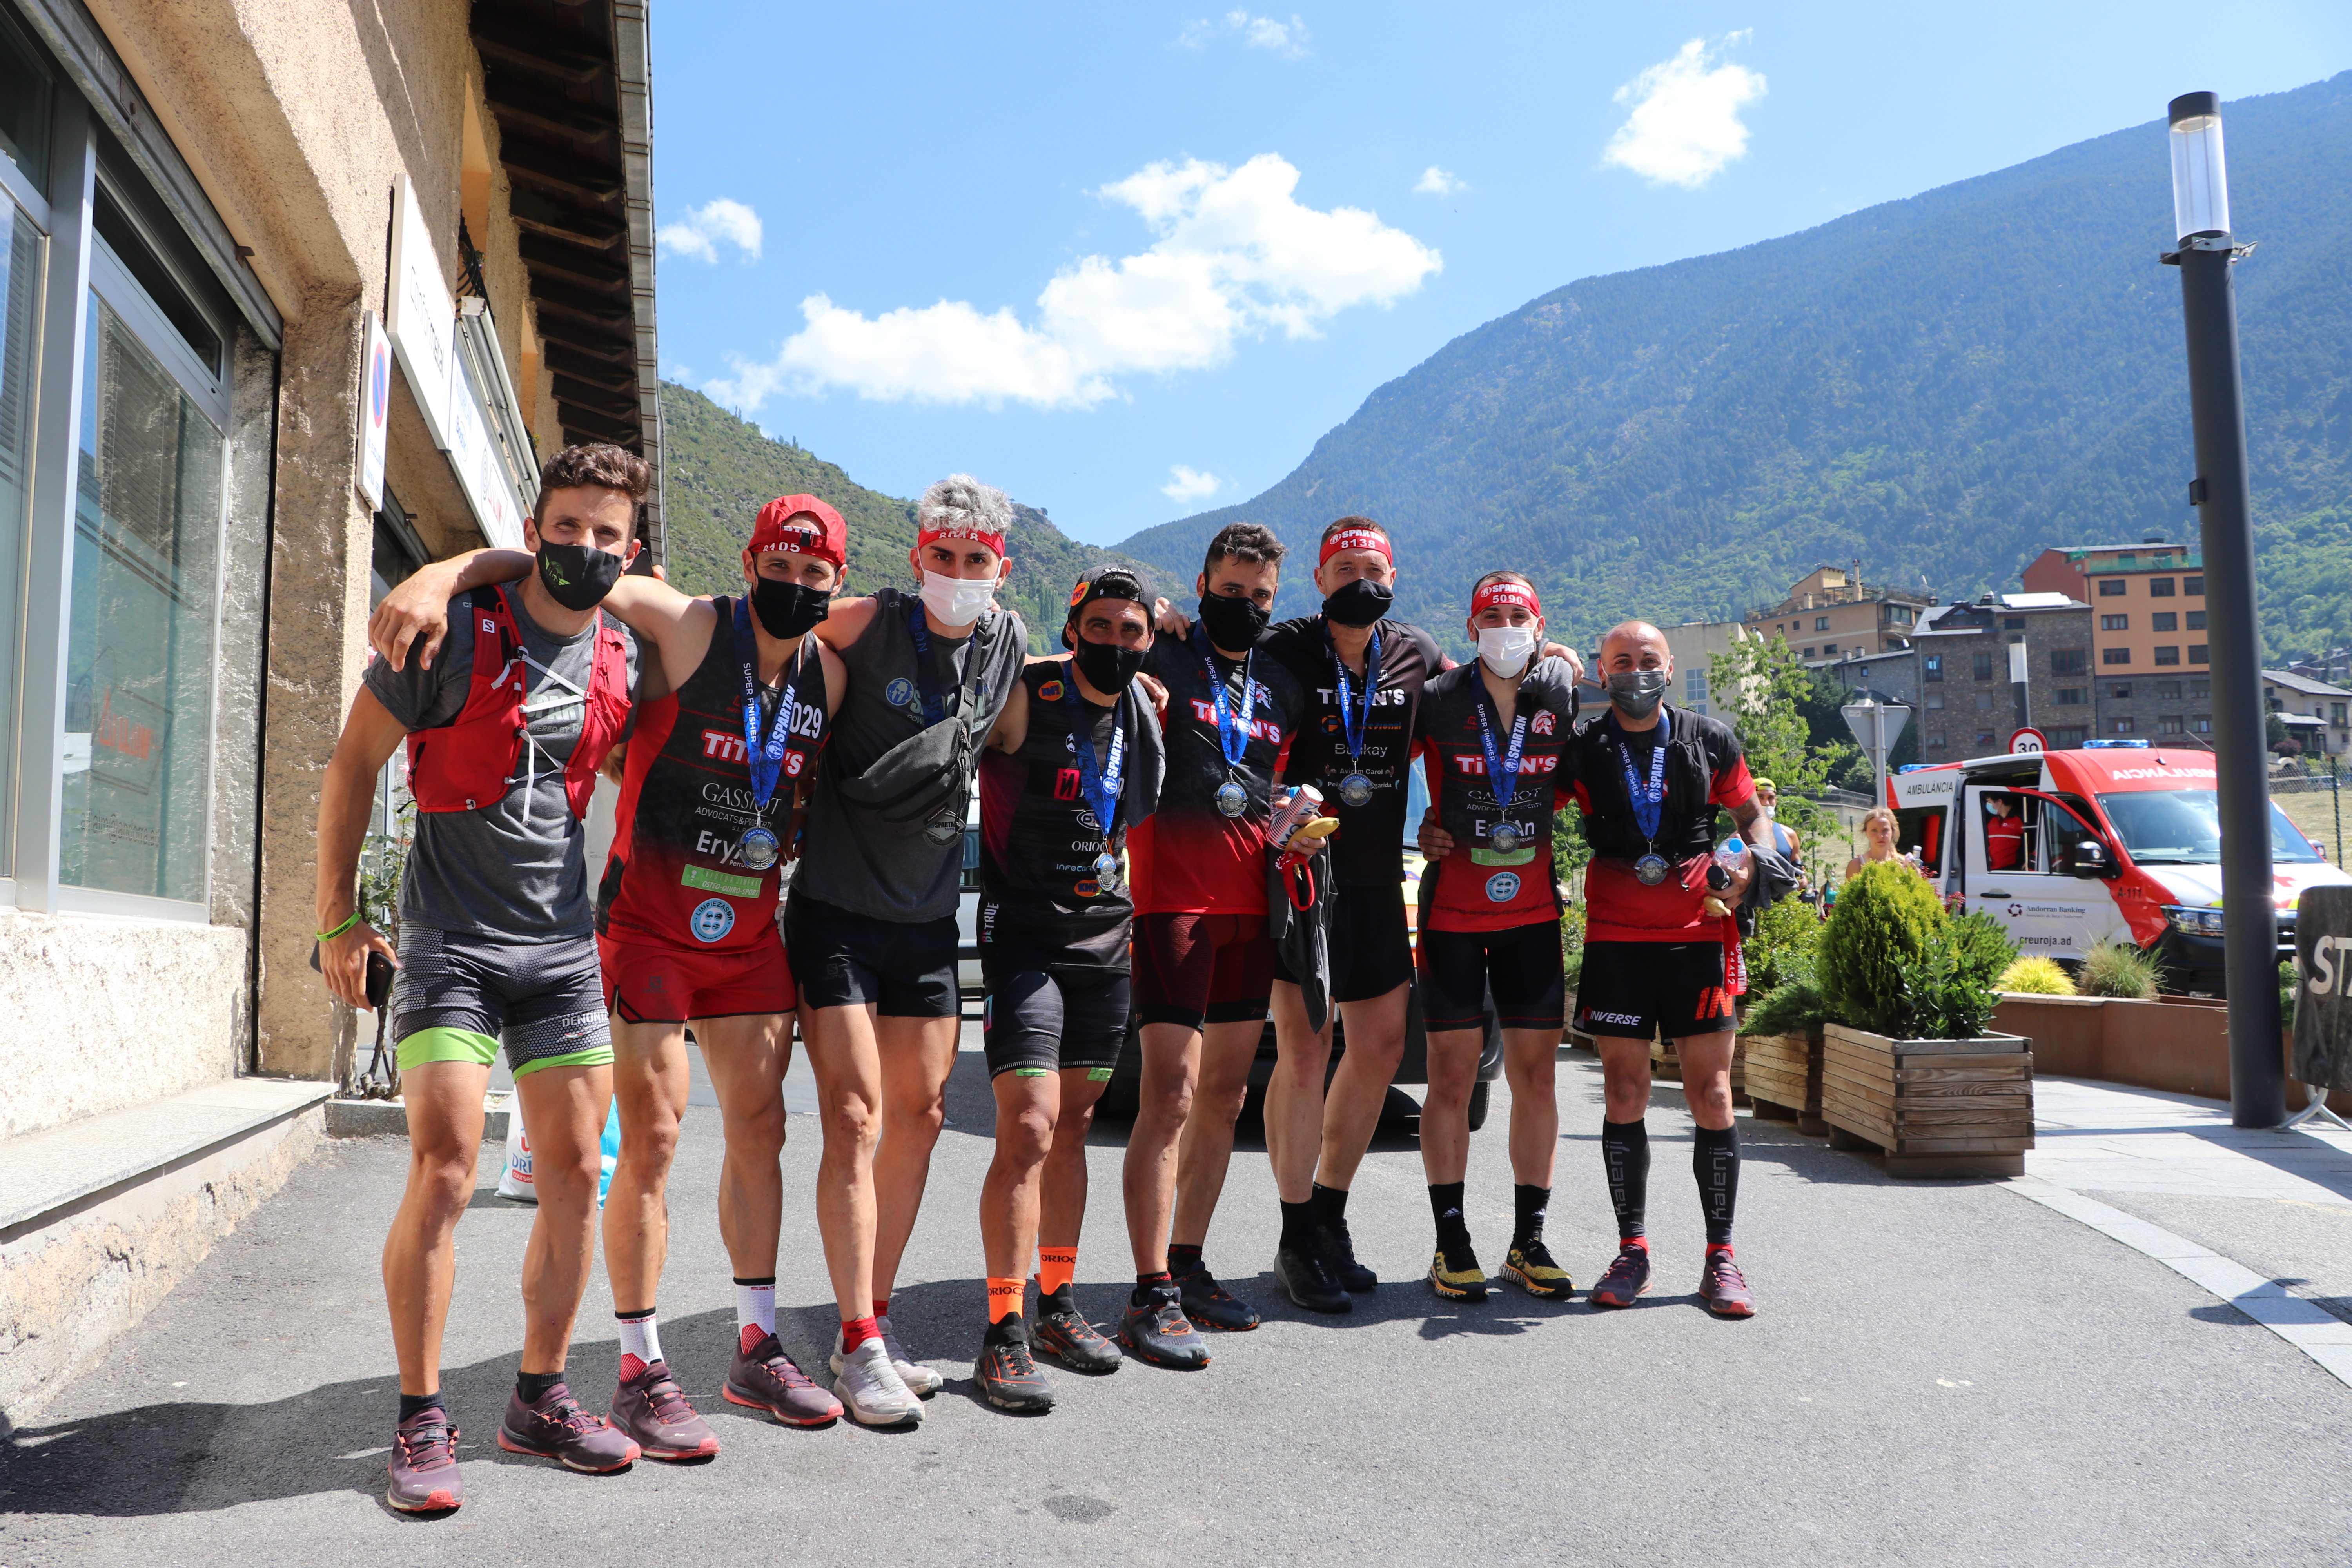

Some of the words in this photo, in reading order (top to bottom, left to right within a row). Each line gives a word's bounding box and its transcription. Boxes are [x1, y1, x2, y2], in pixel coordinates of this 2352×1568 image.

[1341, 539, 1376, 549] 8138
[1342, 529, 1386, 544] SPARTAN
[1492, 584, 1532, 599] SPARTAN
[1492, 594, 1523, 604] 5090
[743, 662, 753, 695] SUPER
[1205, 657, 1217, 679] SUPER
[1213, 681, 1226, 714] FINISHER
[1241, 676, 1256, 720] SPARTAN
[1340, 677, 1349, 711] FINISHER
[747, 697, 757, 742] FINISHER
[772, 684, 795, 743] SPARTAN
[1477, 704, 1488, 728] SUPER
[1483, 728, 1495, 761] FINISHER
[1107, 726, 1124, 778] SPARTAN
[1508, 715, 1527, 759] SPARTAN
[1619, 742, 1630, 764] SUPER
[1626, 764, 1639, 796] FINISHER
[1650, 746, 1665, 789] SPARTAN
[1907, 780, 1953, 795] AMBULÀNCIA
[702, 783, 782, 815] GASSIT
[746, 829, 764, 839] SPARTAN
[764, 831, 774, 841] 2021
[1737, 953, 1747, 993] SPARTAN
[1590, 1010, 1642, 1026] INVERSE
[512, 1152, 532, 1174] DRI
[1606, 1140, 1630, 1216] kalenji
[1708, 1147, 1734, 1220] kalenji
